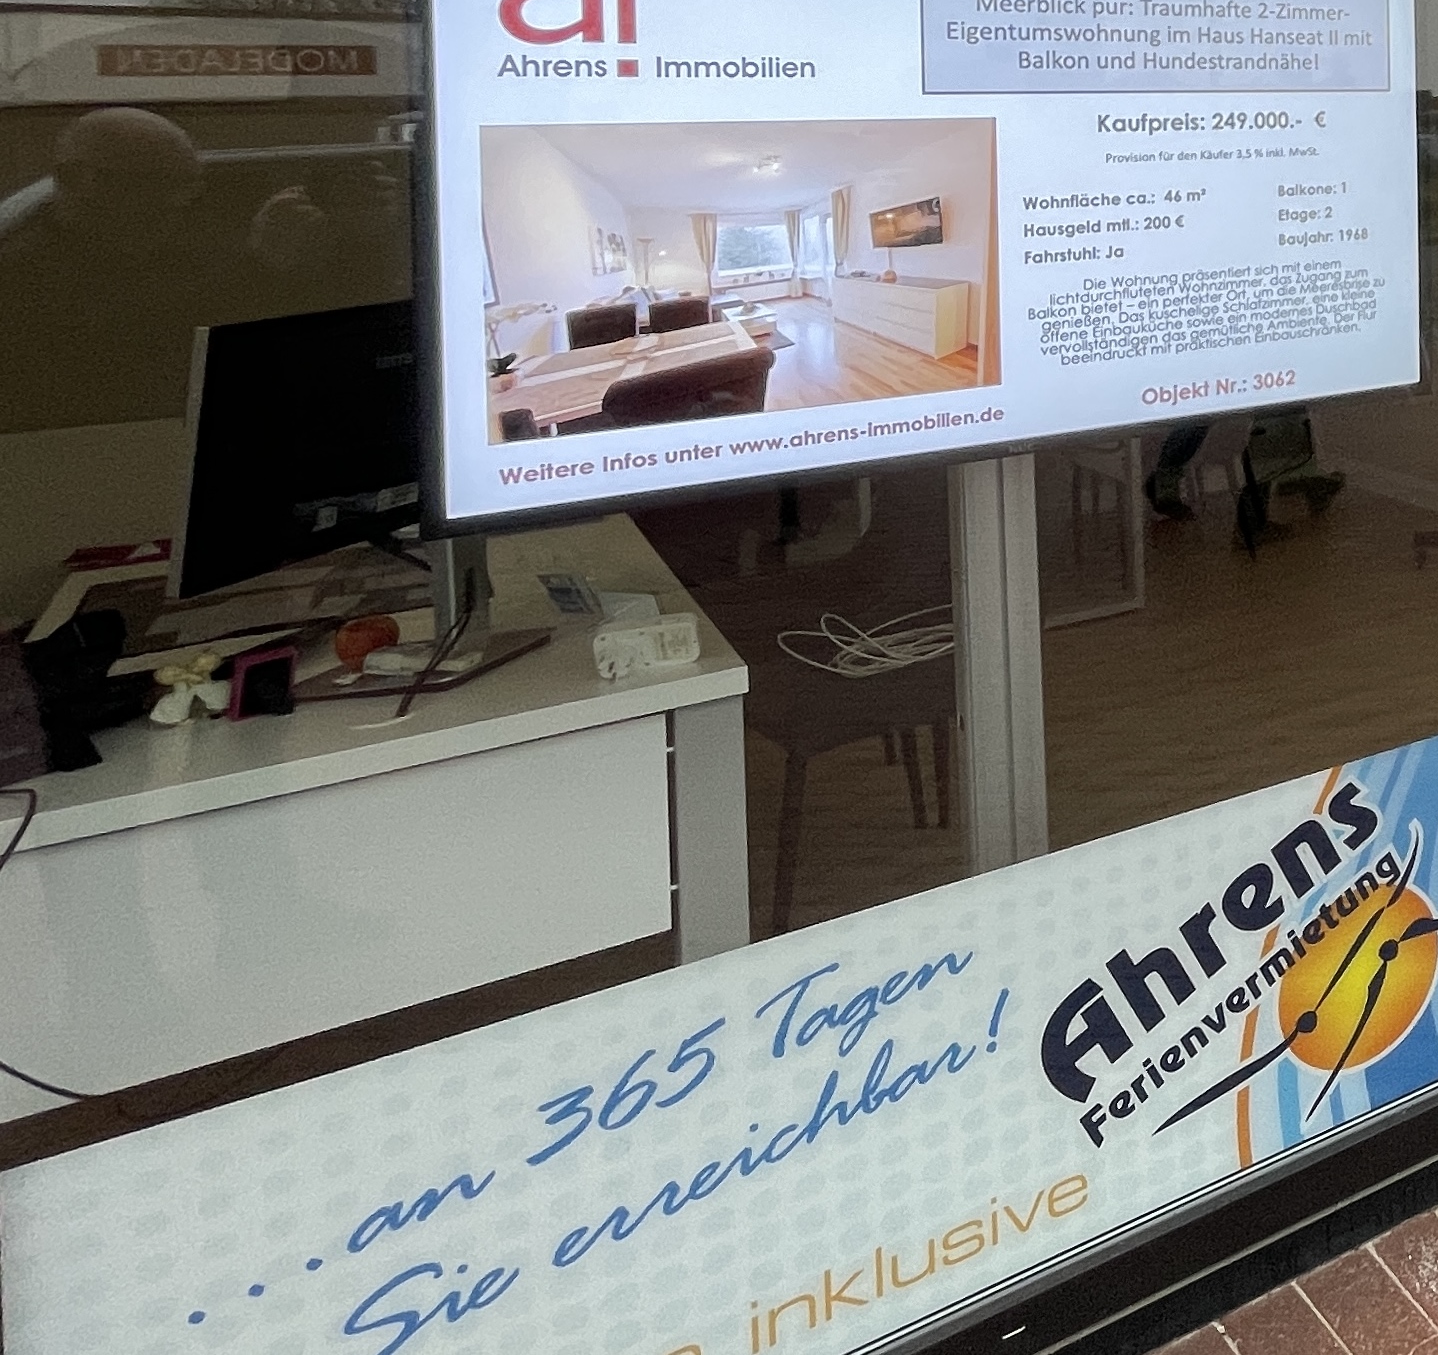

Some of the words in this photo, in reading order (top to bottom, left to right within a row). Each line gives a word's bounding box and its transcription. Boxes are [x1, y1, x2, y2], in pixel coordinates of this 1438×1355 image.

[1093, 0, 1134, 18] pur:
[1257, 2, 1350, 21] 2-Zimmer-
[946, 21, 1161, 47] Eigentumswohnung
[1167, 25, 1191, 43] im
[1198, 26, 1244, 44] Haus
[1250, 28, 1323, 46] Hanseat
[1343, 30, 1373, 46] mit
[497, 54, 607, 78] Ahrens
[655, 55, 816, 79] Immobilien
[1018, 50, 1090, 70] Balkon
[1096, 51, 1136, 70] und
[1097, 113, 1205, 136] Kaufpreis:
[1211, 111, 1302, 130] 249.000.-
[1314, 111, 1327, 128] €
[1105, 153, 1156, 164] Provision
[1158, 151, 1175, 161] für
[1177, 150, 1197, 161] den
[1200, 149, 1234, 161] Käufer
[1254, 148, 1264, 158] %
[1023, 193, 1121, 210] Wohnfläche
[1164, 190, 1182, 202] 46
[1186, 188, 1206, 202] m²
[1278, 184, 1337, 197] Balkone:
[1341, 182, 1347, 193] 1
[1023, 220, 1101, 238] Hausgeld
[1143, 216, 1171, 230] 200
[1175, 215, 1185, 228] €
[1278, 209, 1321, 223] Etage:
[1324, 206, 1333, 219] 2
[1339, 227, 1369, 242] 1968
[1024, 247, 1101, 264] Fahrstuhl:
[1105, 246, 1124, 259] Ja
[1049, 285, 1175, 306] lichtdurchfluteten
[1270, 275, 1292, 287] das
[1295, 271, 1342, 286] Zugang
[1345, 269, 1369, 280] zum
[1083, 278, 1107, 290] Die
[1111, 274, 1178, 288] Wohnung
[1182, 265, 1251, 286] präsentiert
[1254, 264, 1279, 277] sich
[1282, 261, 1301, 273] mit
[1304, 259, 1342, 271] einem
[1028, 303, 1077, 320] Balkon
[1081, 300, 1123, 316] bietet
[1138, 297, 1159, 309] ein
[1163, 291, 1223, 310] perfekter
[1253, 288, 1274, 299] um
[1277, 284, 1297, 296] die
[1300, 278, 1371, 294] Meeresbrise
[1373, 278, 1386, 288] zu
[1119, 311, 1145, 324] Das
[1149, 303, 1220, 322] kuschelige
[1312, 292, 1339, 304] eine
[1341, 289, 1375, 301] kleine
[1040, 329, 1088, 344] offene
[1093, 319, 1183, 339] Einbauküche
[1187, 315, 1224, 328] sowie
[1228, 312, 1247, 324] ein
[1250, 306, 1312, 321] modernes
[1315, 299, 1377, 315] Duschbad
[1040, 334, 1158, 355] vervollständigen
[1162, 331, 1186, 343] das
[1190, 322, 1263, 342] gemütliche
[1334, 313, 1355, 323] Der
[1061, 346, 1146, 366] beeindruckt
[1151, 343, 1171, 355] mit
[1175, 333, 1251, 355] praktischen
[1142, 380, 1210, 406] Objekt
[1216, 377, 1248, 396] Nr.:
[1253, 370, 1296, 390] 3062
[499, 460, 595, 485] Weitere
[603, 452, 658, 473] Infos
[665, 444, 723, 464] unter
[729, 406, 1004, 455] www.ahrens-immobilien.de
[1041, 781, 1379, 1104] Ahrens
[1079, 851, 1402, 1148] Ferienvermietung
[526, 1017, 725, 1166] 365
[755, 950, 972, 1059] Tagen
[344, 1262, 520, 1355] Sie
[552, 989, 1010, 1268] erreichbar!
[751, 1173, 1089, 1355] inklusive
